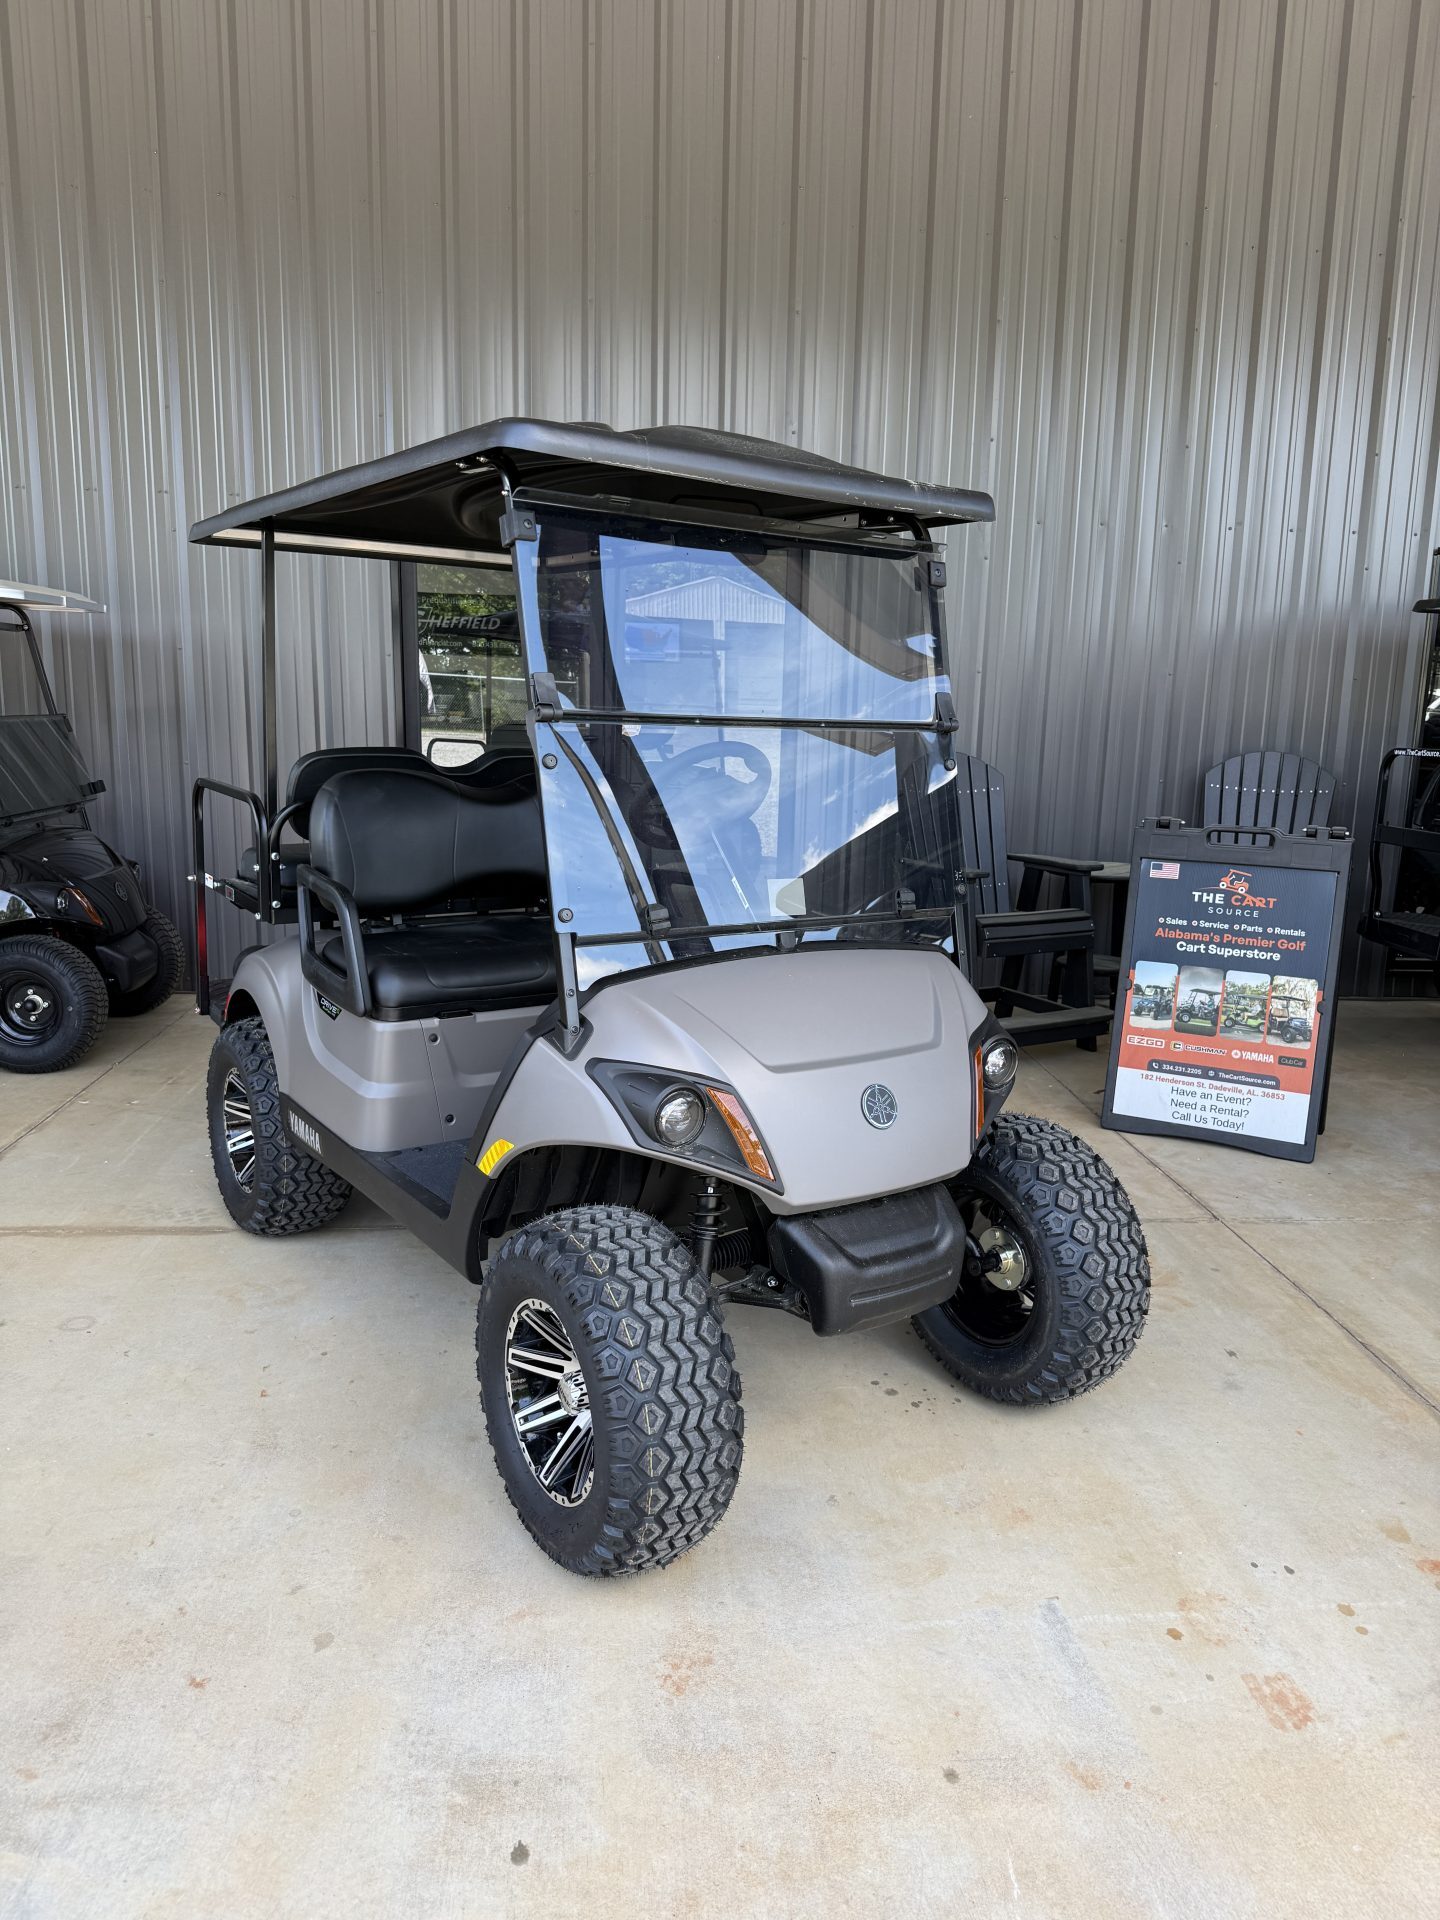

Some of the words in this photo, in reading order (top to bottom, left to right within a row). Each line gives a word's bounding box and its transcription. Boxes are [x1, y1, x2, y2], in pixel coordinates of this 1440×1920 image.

[1192, 891, 1225, 904] THE
[1231, 895, 1278, 909] CART
[1208, 906, 1260, 918] SOURCE
[1165, 917, 1188, 926] Sales
[1199, 920, 1230, 930] Service
[1241, 923, 1263, 933] Parts
[1274, 927, 1306, 937] Rentals
[1155, 927, 1220, 943] Alabama's
[1223, 934, 1275, 949] Premier
[1277, 939, 1306, 951] Golf
[1176, 941, 1206, 954] Cart
[1208, 944, 1281, 961] Superstore
[1184, 1044, 1226, 1056] CUSHMAN
[1241, 1051, 1275, 1064] YAMAHA
[1161, 1063, 1202, 1075] 334.231.2205
[1281, 1057, 1294, 1065] Club
[1140, 1073, 1154, 1081] 182
[1155, 1075, 1195, 1088] Henderson
[1196, 1081, 1206, 1089] St.
[1208, 1083, 1244, 1095] Dadeville,
[1246, 1088, 1259, 1097] AL.
[1260, 1090, 1286, 1101] 36853
[1218, 1072, 1276, 1087] TheCartSource.com
[1170, 1086, 1197, 1098] Have
[1200, 1092, 1213, 1100] an
[1216, 1092, 1252, 1106] Event?
[1170, 1098, 1197, 1111] Need
[1200, 1104, 1206, 1112] a
[1209, 1104, 1250, 1118] Rental?
[1171, 1111, 1191, 1122] Call
[1194, 1115, 1208, 1125] Us
[1210, 1117, 1245, 1131] Today!
[289, 1110, 322, 1154] YAMAHA
